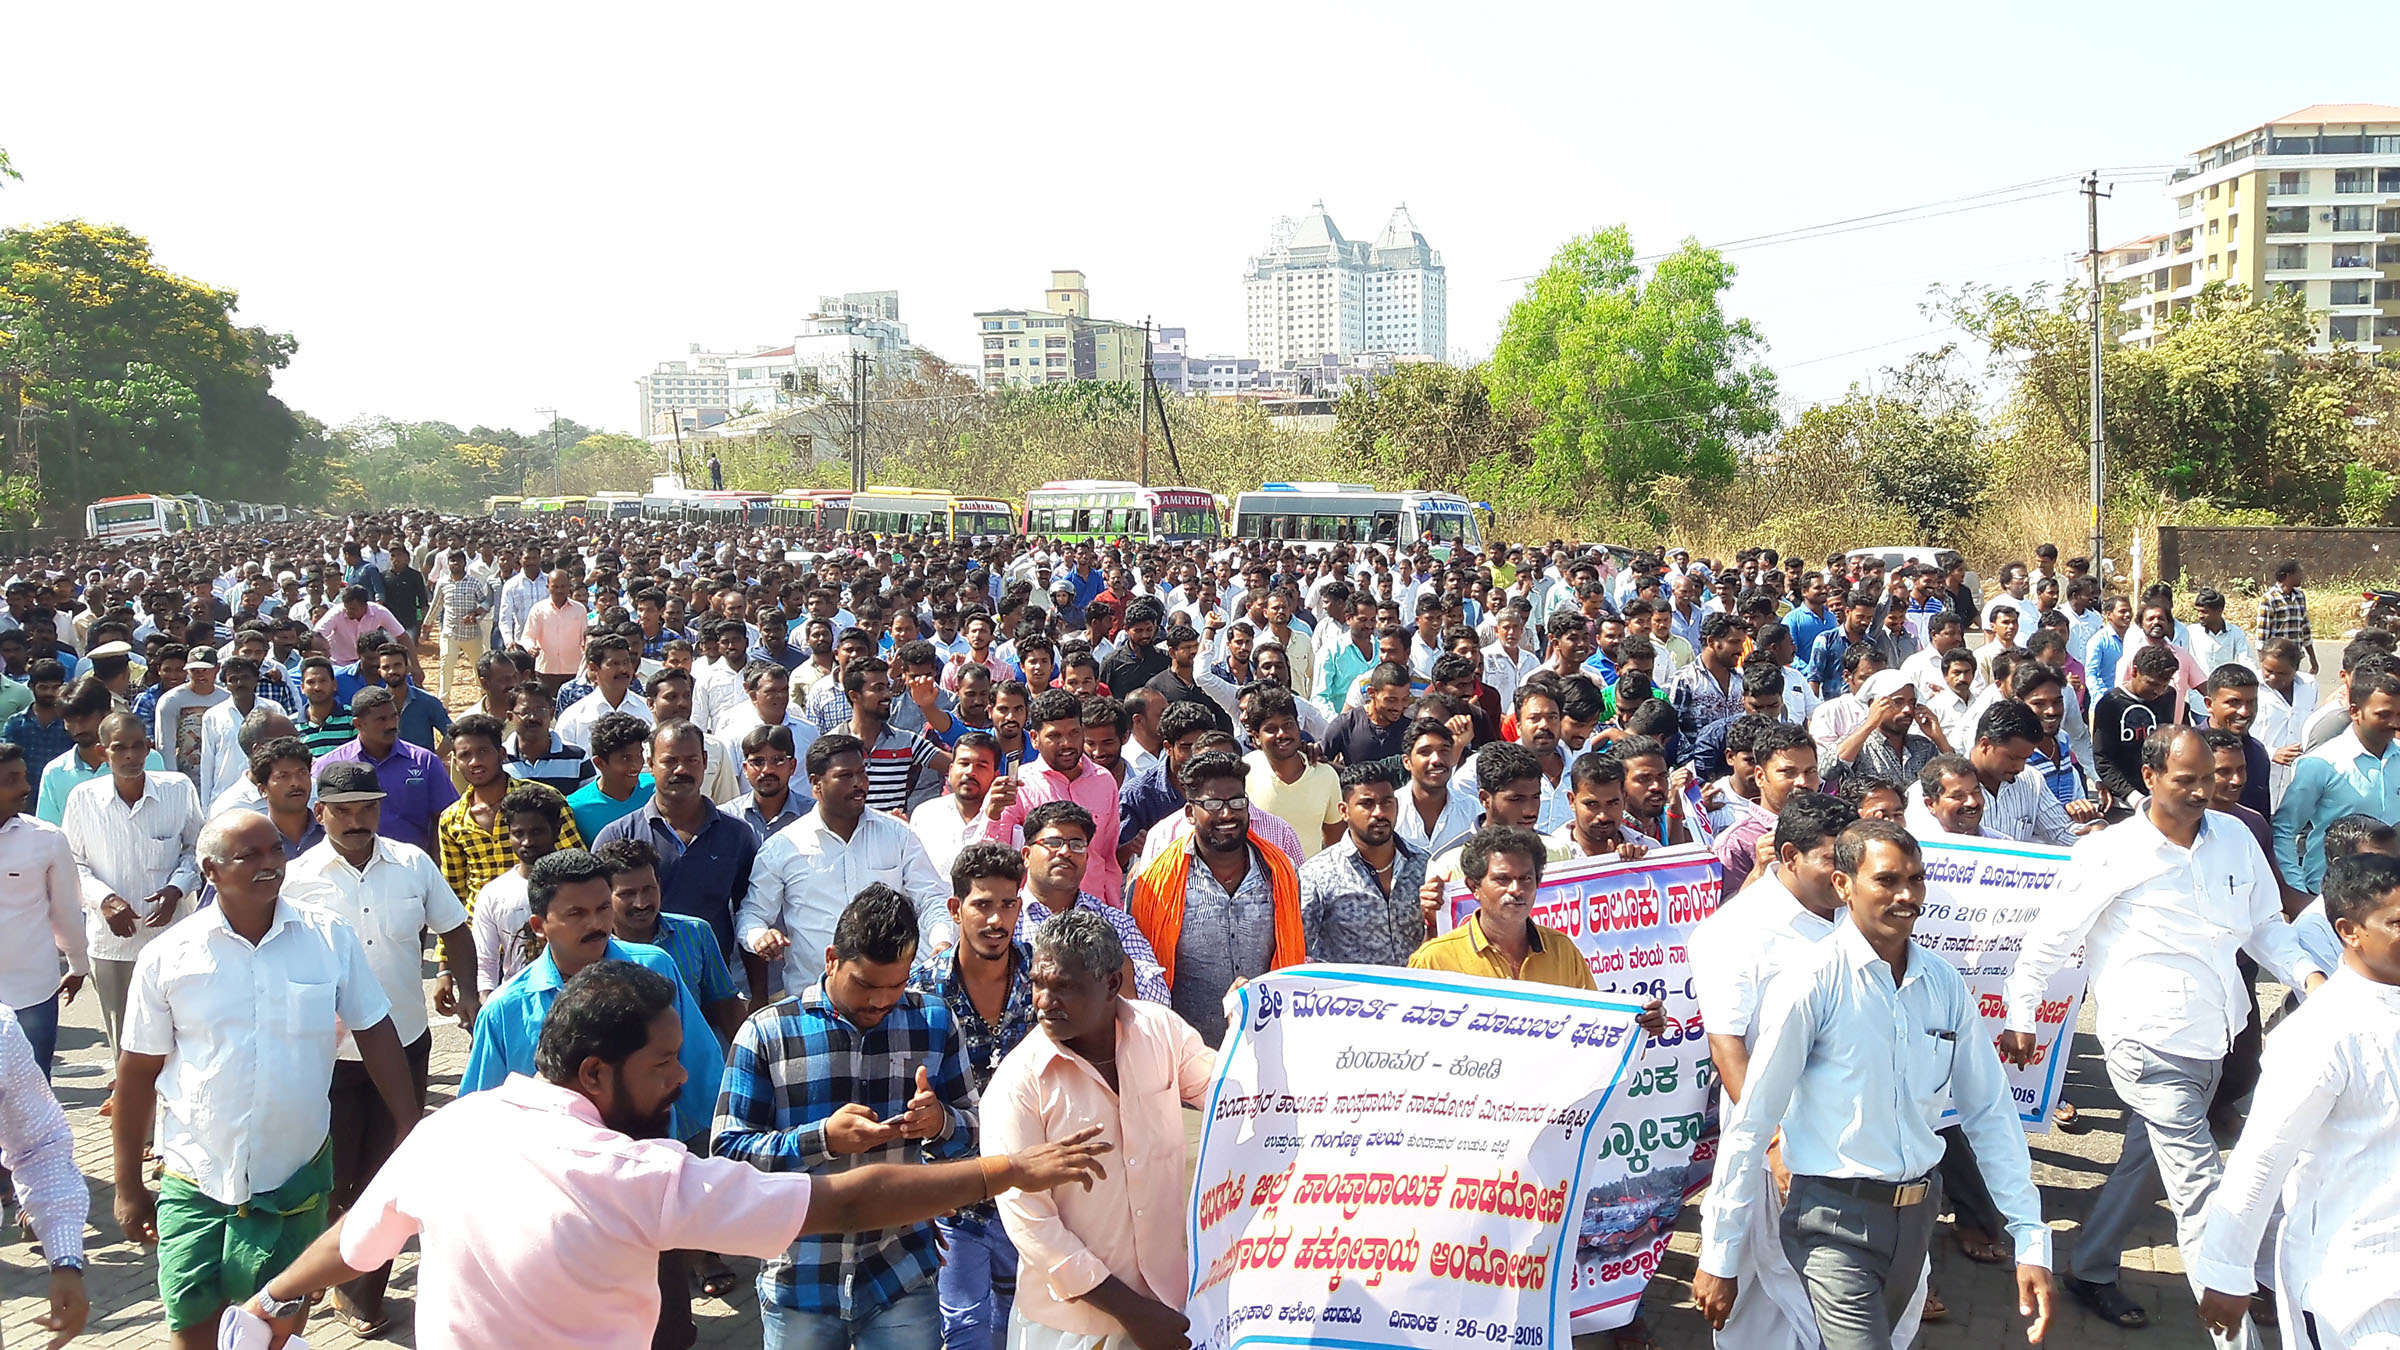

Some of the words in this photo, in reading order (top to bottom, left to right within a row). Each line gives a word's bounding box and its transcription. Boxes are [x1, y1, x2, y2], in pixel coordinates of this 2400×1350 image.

[1955, 906, 1987, 922] 216
[1629, 943, 1664, 969] ವಲಯ
[1254, 983, 1283, 1032] ಶ್ರೀ
[1292, 987, 1397, 1021] ಮಂದಾರ್ತಿ
[1401, 1000, 1468, 1029] ಮಾತೆ
[1570, 1018, 1629, 1048] ಘಟಕ
[1336, 1045, 1430, 1071] ಕುಂದಾಪುರ
[1448, 1054, 1503, 1080] ಕೋಡಿ
[1198, 1168, 1247, 1232] ಉಡುಪಿ
[1249, 1161, 1296, 1221] ಜಿಲ್ಲೆ
[1429, 1234, 1551, 1292] ಆಂದೋಲನ
[1388, 1310, 1440, 1333] ದಿನಾಂಕ
[1455, 1318, 1544, 1347] 26-02-2018
